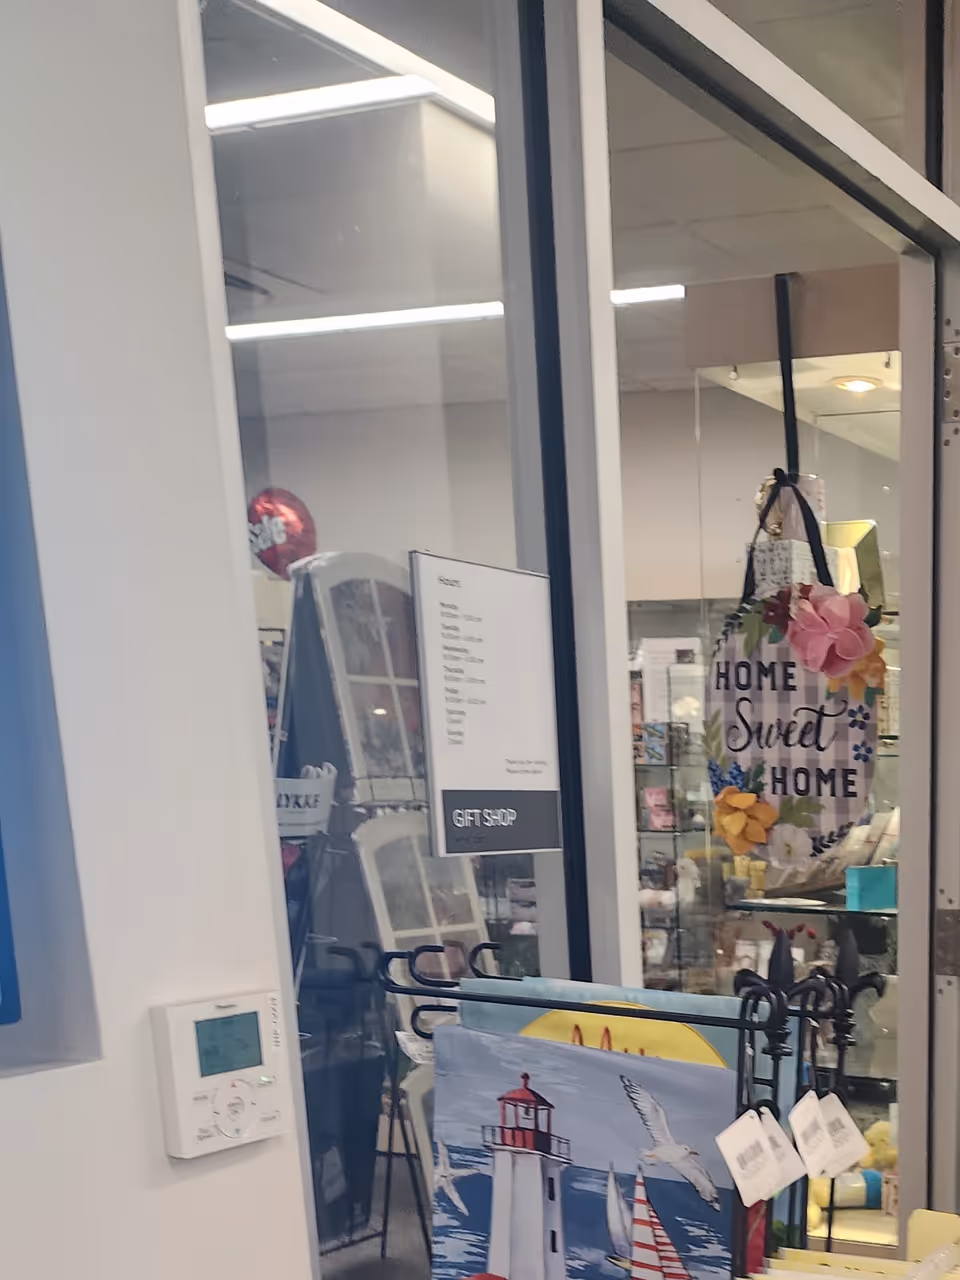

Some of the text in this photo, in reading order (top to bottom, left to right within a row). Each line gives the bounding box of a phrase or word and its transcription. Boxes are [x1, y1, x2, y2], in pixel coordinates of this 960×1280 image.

[715, 660, 798, 692] HOME
[727, 696, 849, 752] Sweet
[770, 766, 858, 798] HOME
[452, 808, 518, 828] GIFT SHOP
